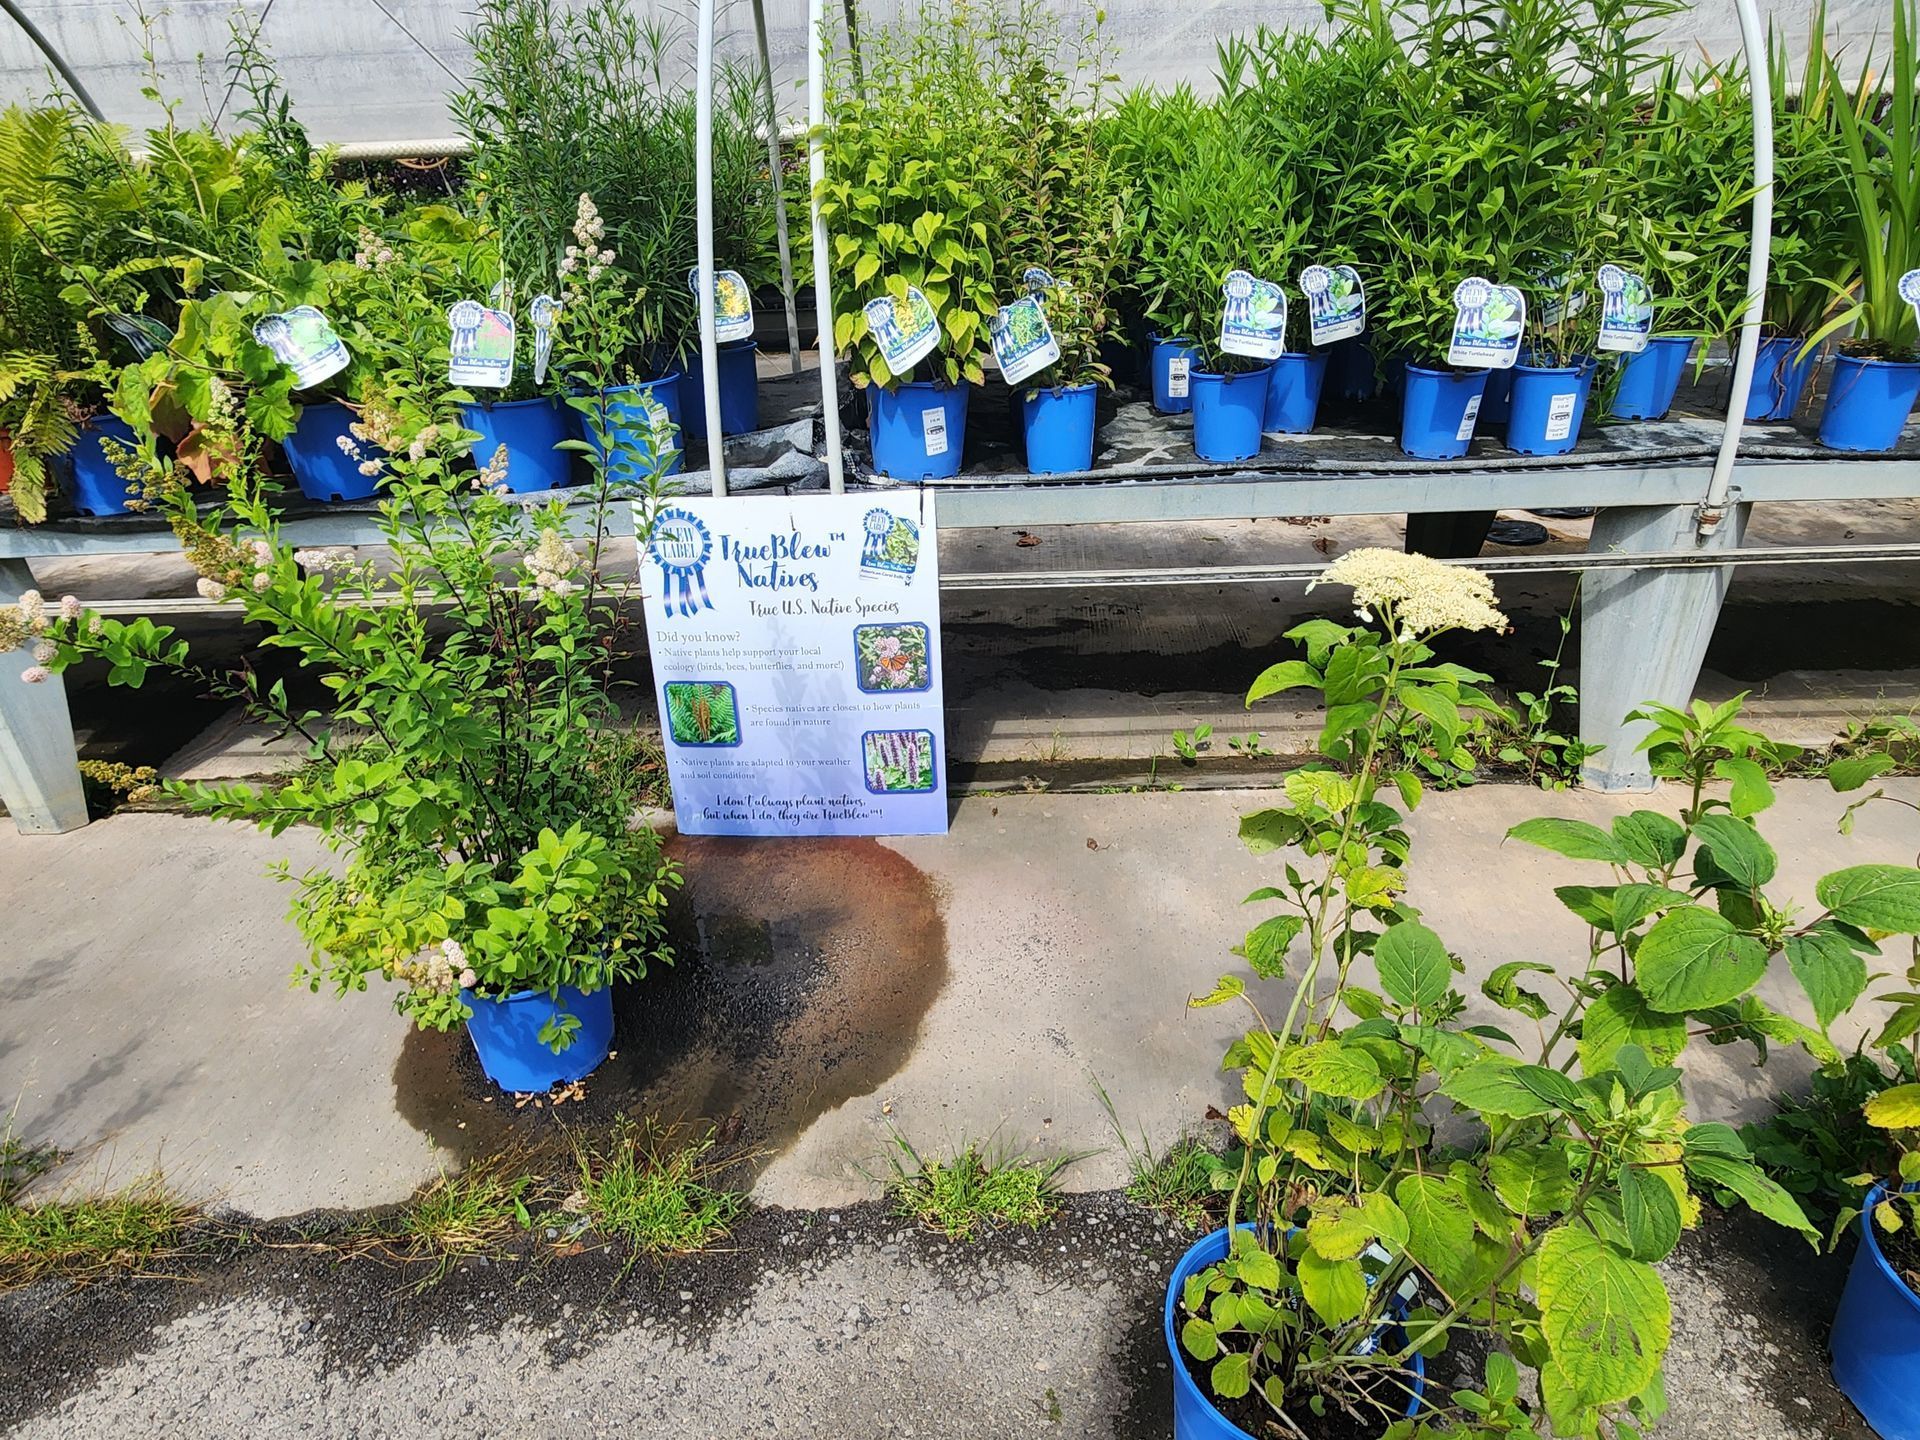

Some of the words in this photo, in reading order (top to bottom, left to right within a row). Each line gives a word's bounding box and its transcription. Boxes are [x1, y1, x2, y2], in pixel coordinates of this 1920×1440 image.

[663, 543, 698, 558] LABEL
[738, 561, 819, 592] Natives
[749, 599, 779, 617] True
[782, 598, 807, 615] U.S.
[811, 597, 852, 616] Native
[855, 596, 899, 618] Species
[656, 630, 678, 642] Did
[681, 633, 702, 645] you
[705, 630, 741, 642] know?
[664, 647, 693, 657] Native
[694, 647, 720, 659] plants
[722, 647, 741, 659] help
[743, 648, 776, 658] support
[779, 648, 799, 658] your
[801, 646, 821, 656] local
[664, 662, 695, 673] ecology
[697, 662, 725, 673] (birds,
[726, 662, 747, 672] bees,
[749, 661, 795, 671] butterflies,
[797, 661, 813, 669] and
[751, 704, 783, 715] Species
[786, 704, 815, 712] natives
[832, 703, 860, 711] closest
[873, 702, 892, 711] how
[894, 701, 920, 712] plants
[765, 717, 790, 726] found
[792, 718, 800, 726] in
[803, 718, 831, 726] nature
[681, 757, 709, 766] Native
[709, 757, 734, 768] plants
[751, 758, 783, 768] adapted
[796, 760, 815, 768] your
[818, 757, 851, 766] weather
[680, 770, 695, 779] and
[697, 770, 711, 779] soil
[713, 771, 756, 779] conditions
[716, 794, 720, 806] I
[754, 794, 793, 809] always
[796, 793, 826, 809] plant
[723, 809, 748, 820] when
[751, 808, 756, 820] I
[778, 808, 800, 827] they
[802, 810, 820, 820] are
